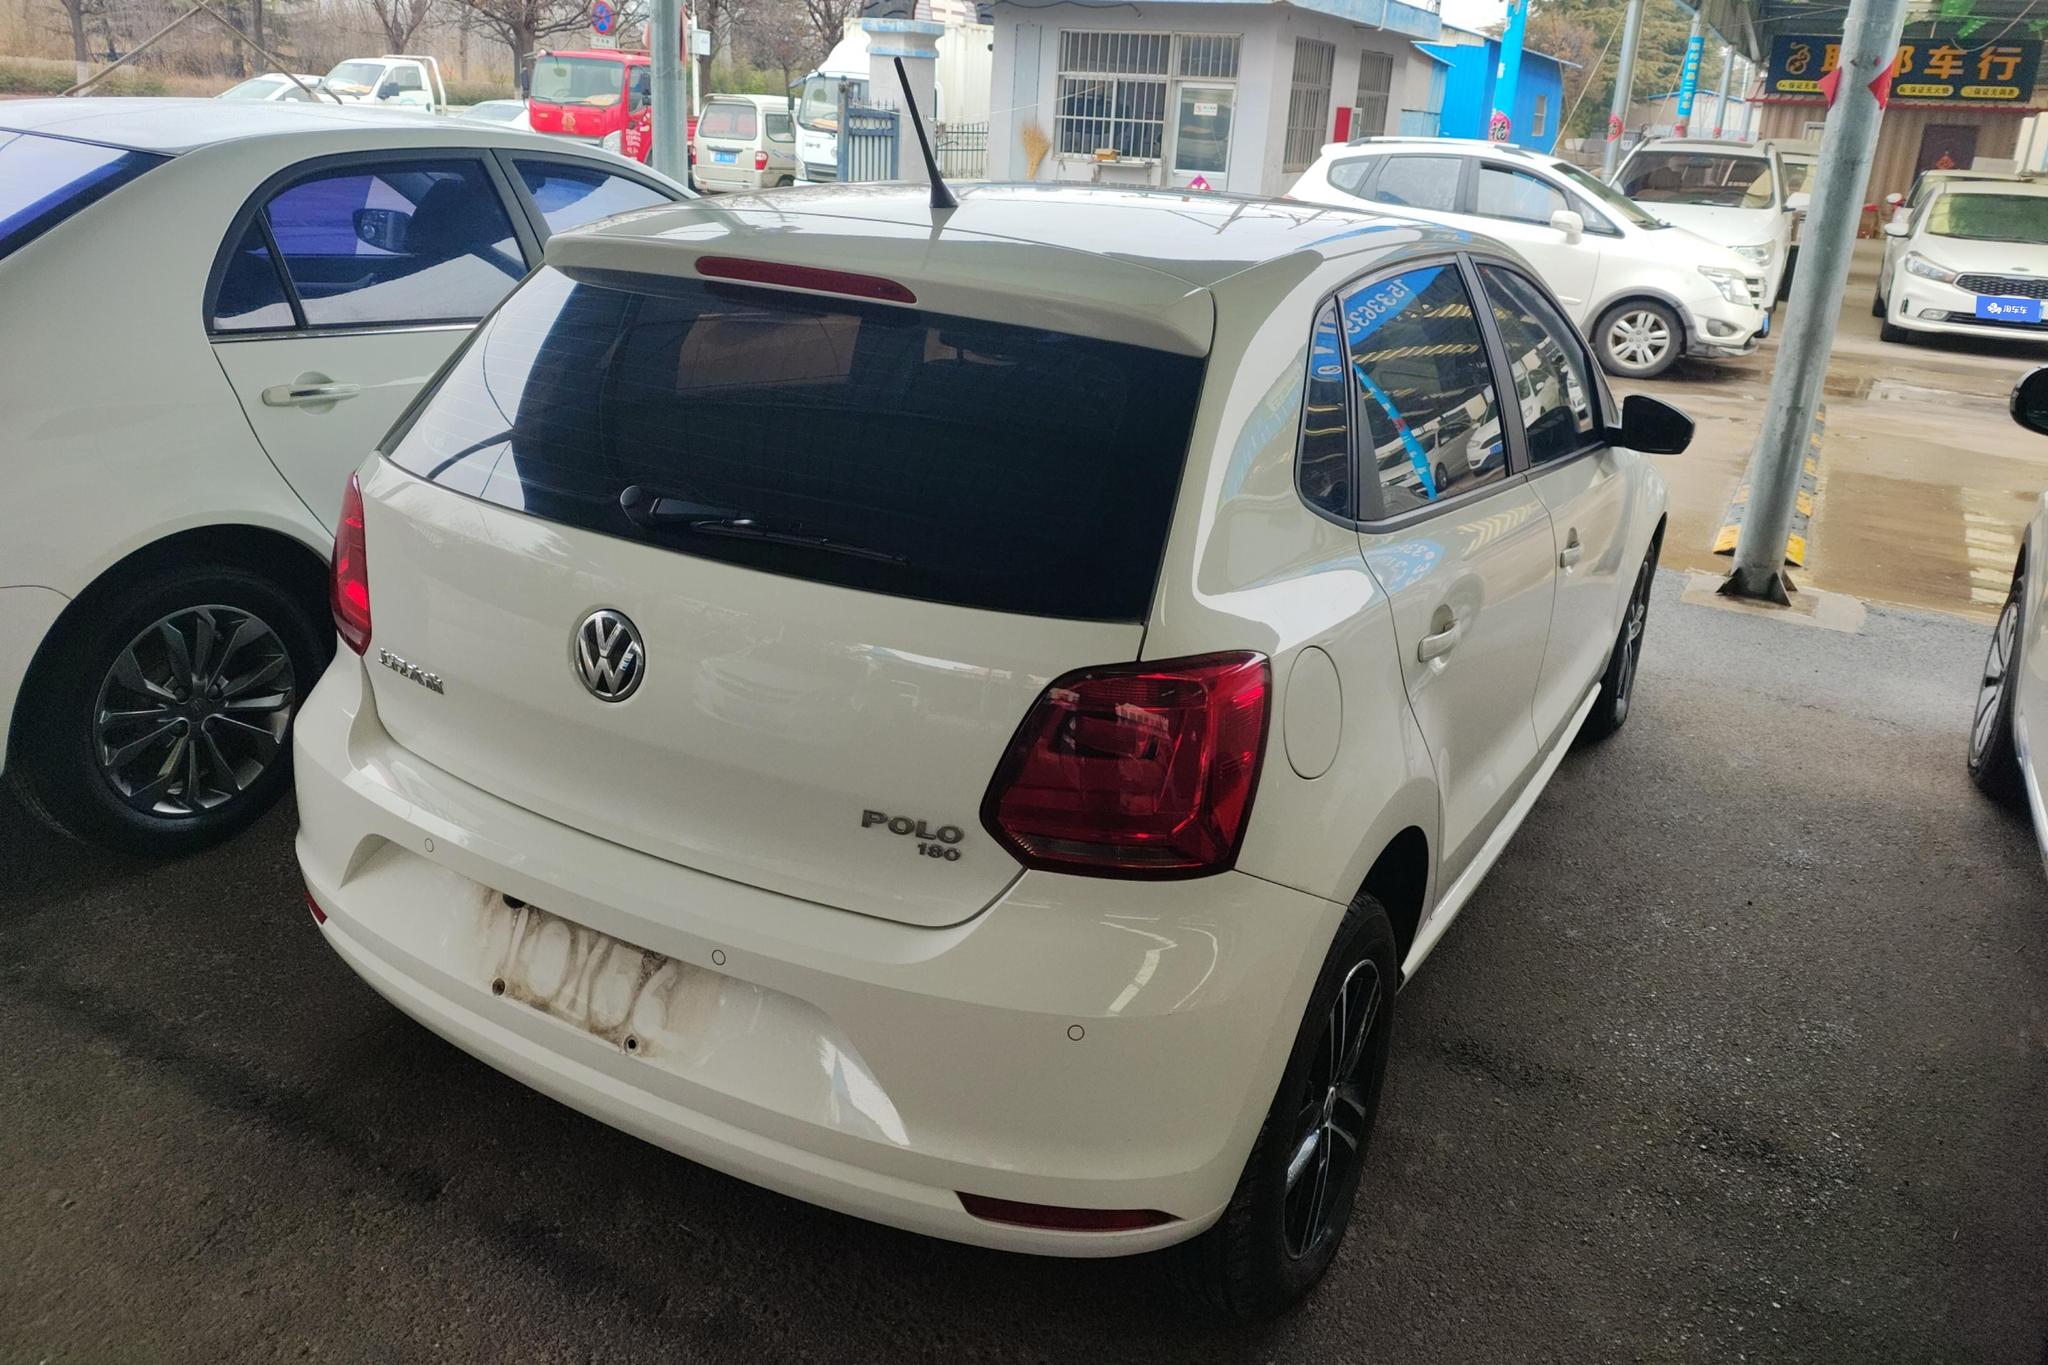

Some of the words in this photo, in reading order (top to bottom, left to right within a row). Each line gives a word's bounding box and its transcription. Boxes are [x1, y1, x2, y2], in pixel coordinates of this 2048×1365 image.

[1788, 81, 1819, 90] 保证无事
[861, 809, 965, 844] POLO
[917, 842, 961, 862] 180
